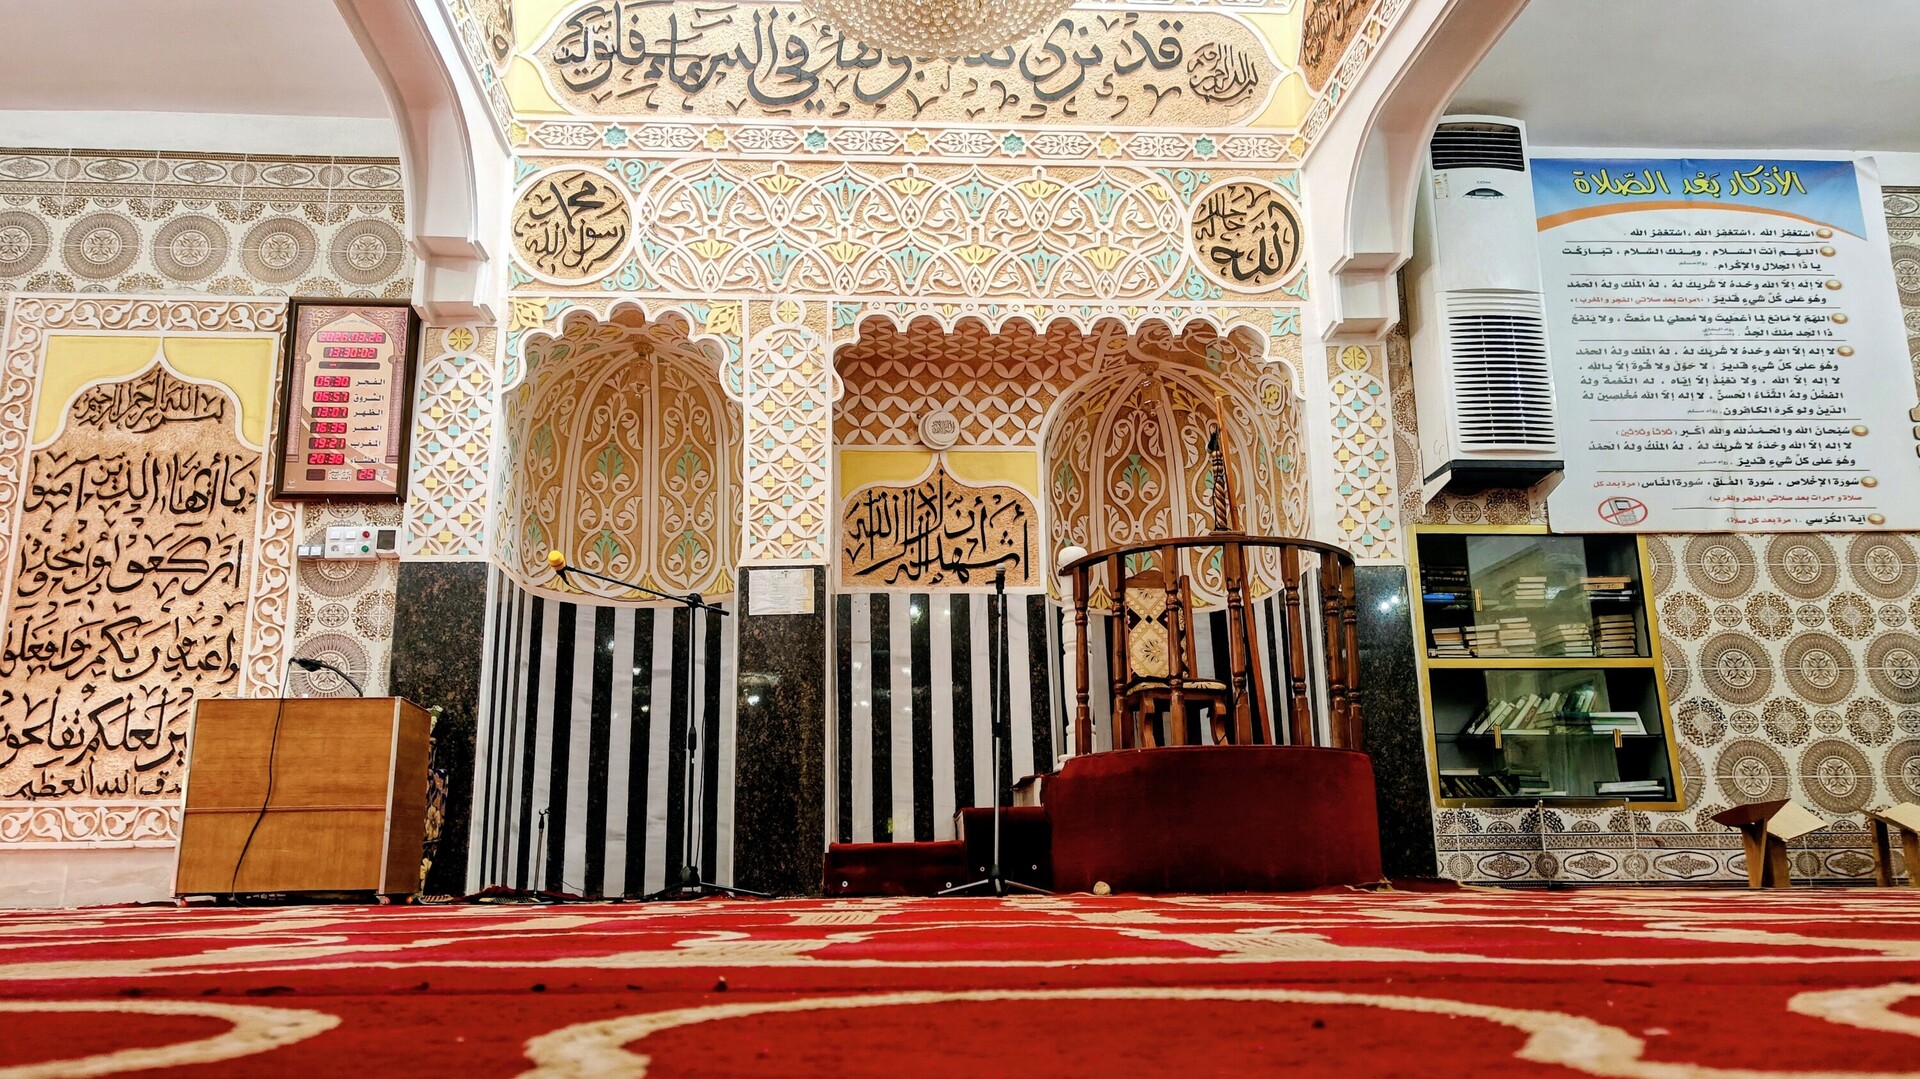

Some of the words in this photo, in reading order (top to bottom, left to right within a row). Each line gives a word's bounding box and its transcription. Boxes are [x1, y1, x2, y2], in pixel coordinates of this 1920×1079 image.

[1729, 165, 1807, 196] الأذكار
[1811, 262, 1821, 271] يا
[1761, 280, 1779, 288] الله
[1772, 347, 1789, 355] الله
[1772, 376, 1789, 384] الله
[1641, 391, 1658, 399] الله
[1795, 426, 1812, 434] الله
[1789, 441, 1806, 449] الله
